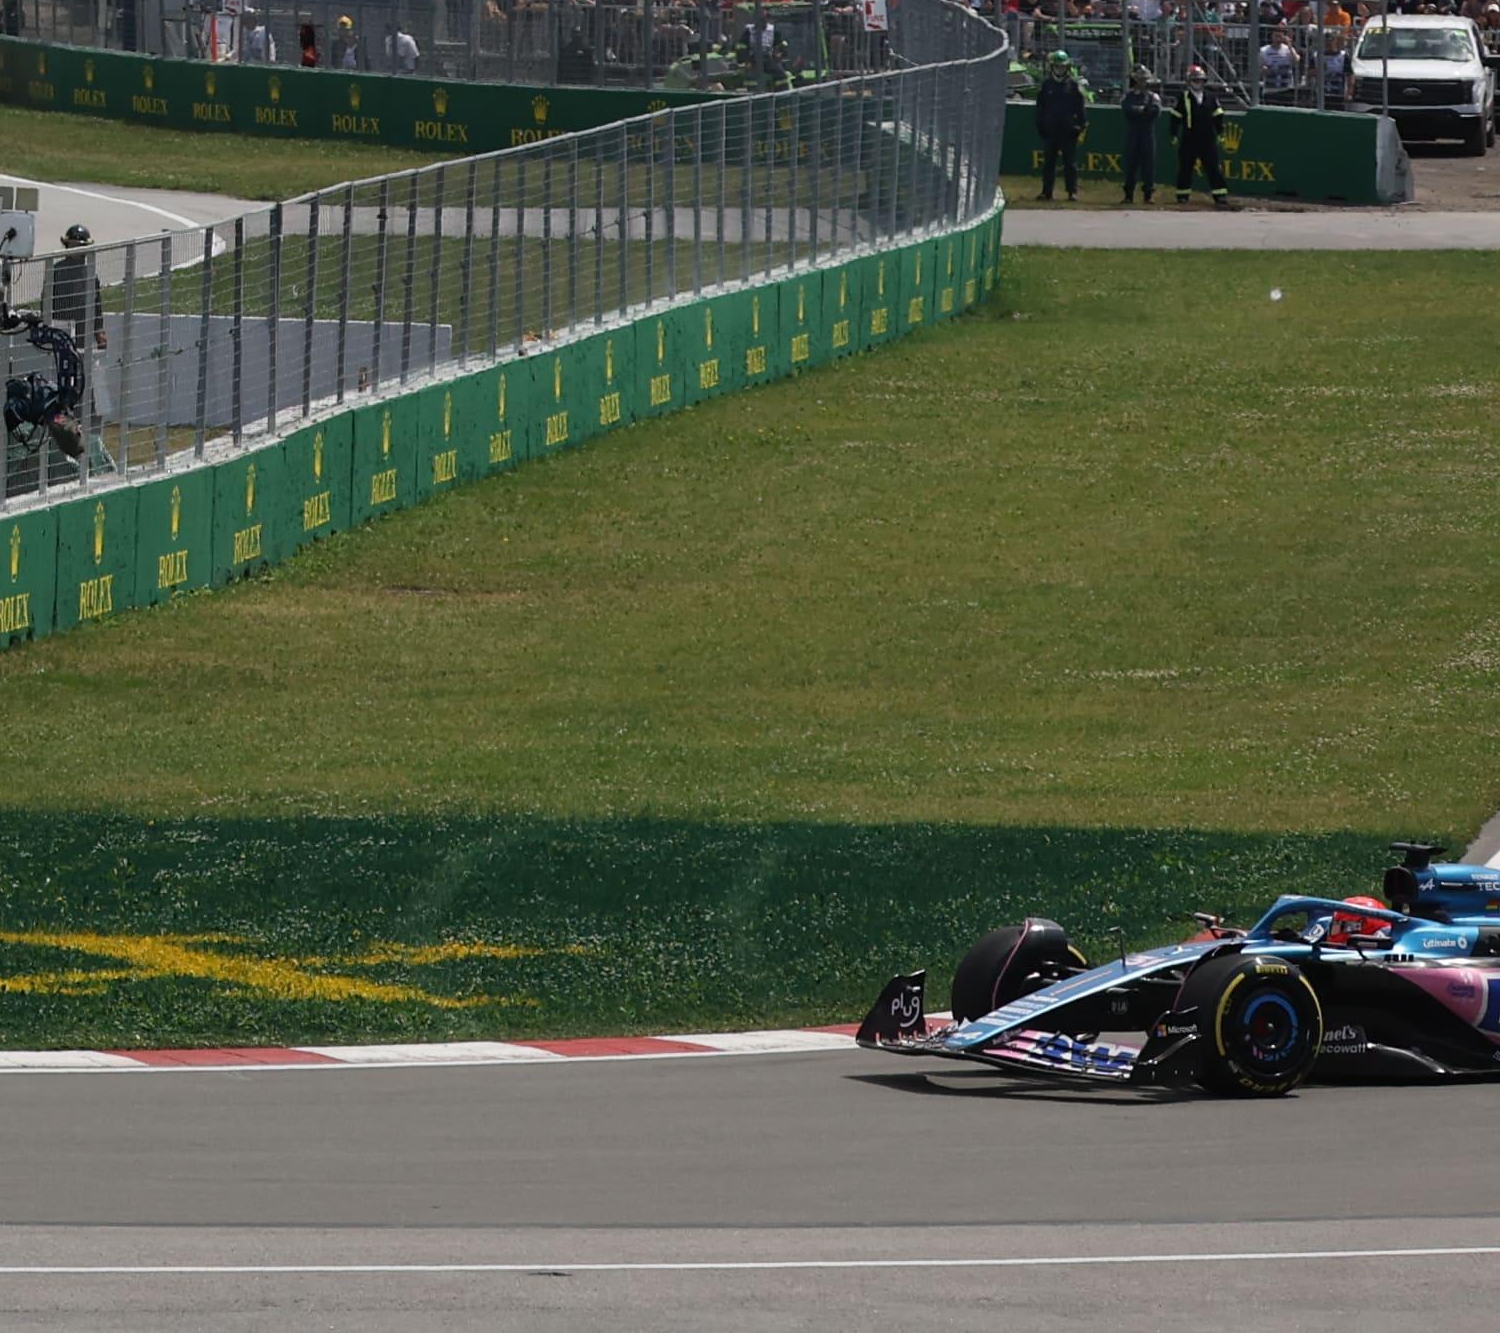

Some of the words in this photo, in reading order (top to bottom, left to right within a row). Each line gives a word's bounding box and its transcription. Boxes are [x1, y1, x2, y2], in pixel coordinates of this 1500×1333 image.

[72, 88, 107, 107] ROLEX
[131, 96, 166, 113] ROLEX
[193, 102, 231, 121] ROLEX
[256, 107, 296, 127] ROLEX
[332, 115, 379, 133] ROLEX
[414, 121, 468, 142] ROLEX
[233, 524, 262, 565] ROLEX
[158, 549, 188, 588] ROLEX
[79, 575, 116, 620] ROLEX
[1255, 964, 1288, 975] PIRELLI
[891, 993, 920, 1027] plug
[1167, 1023, 1199, 1035] Microsoft
